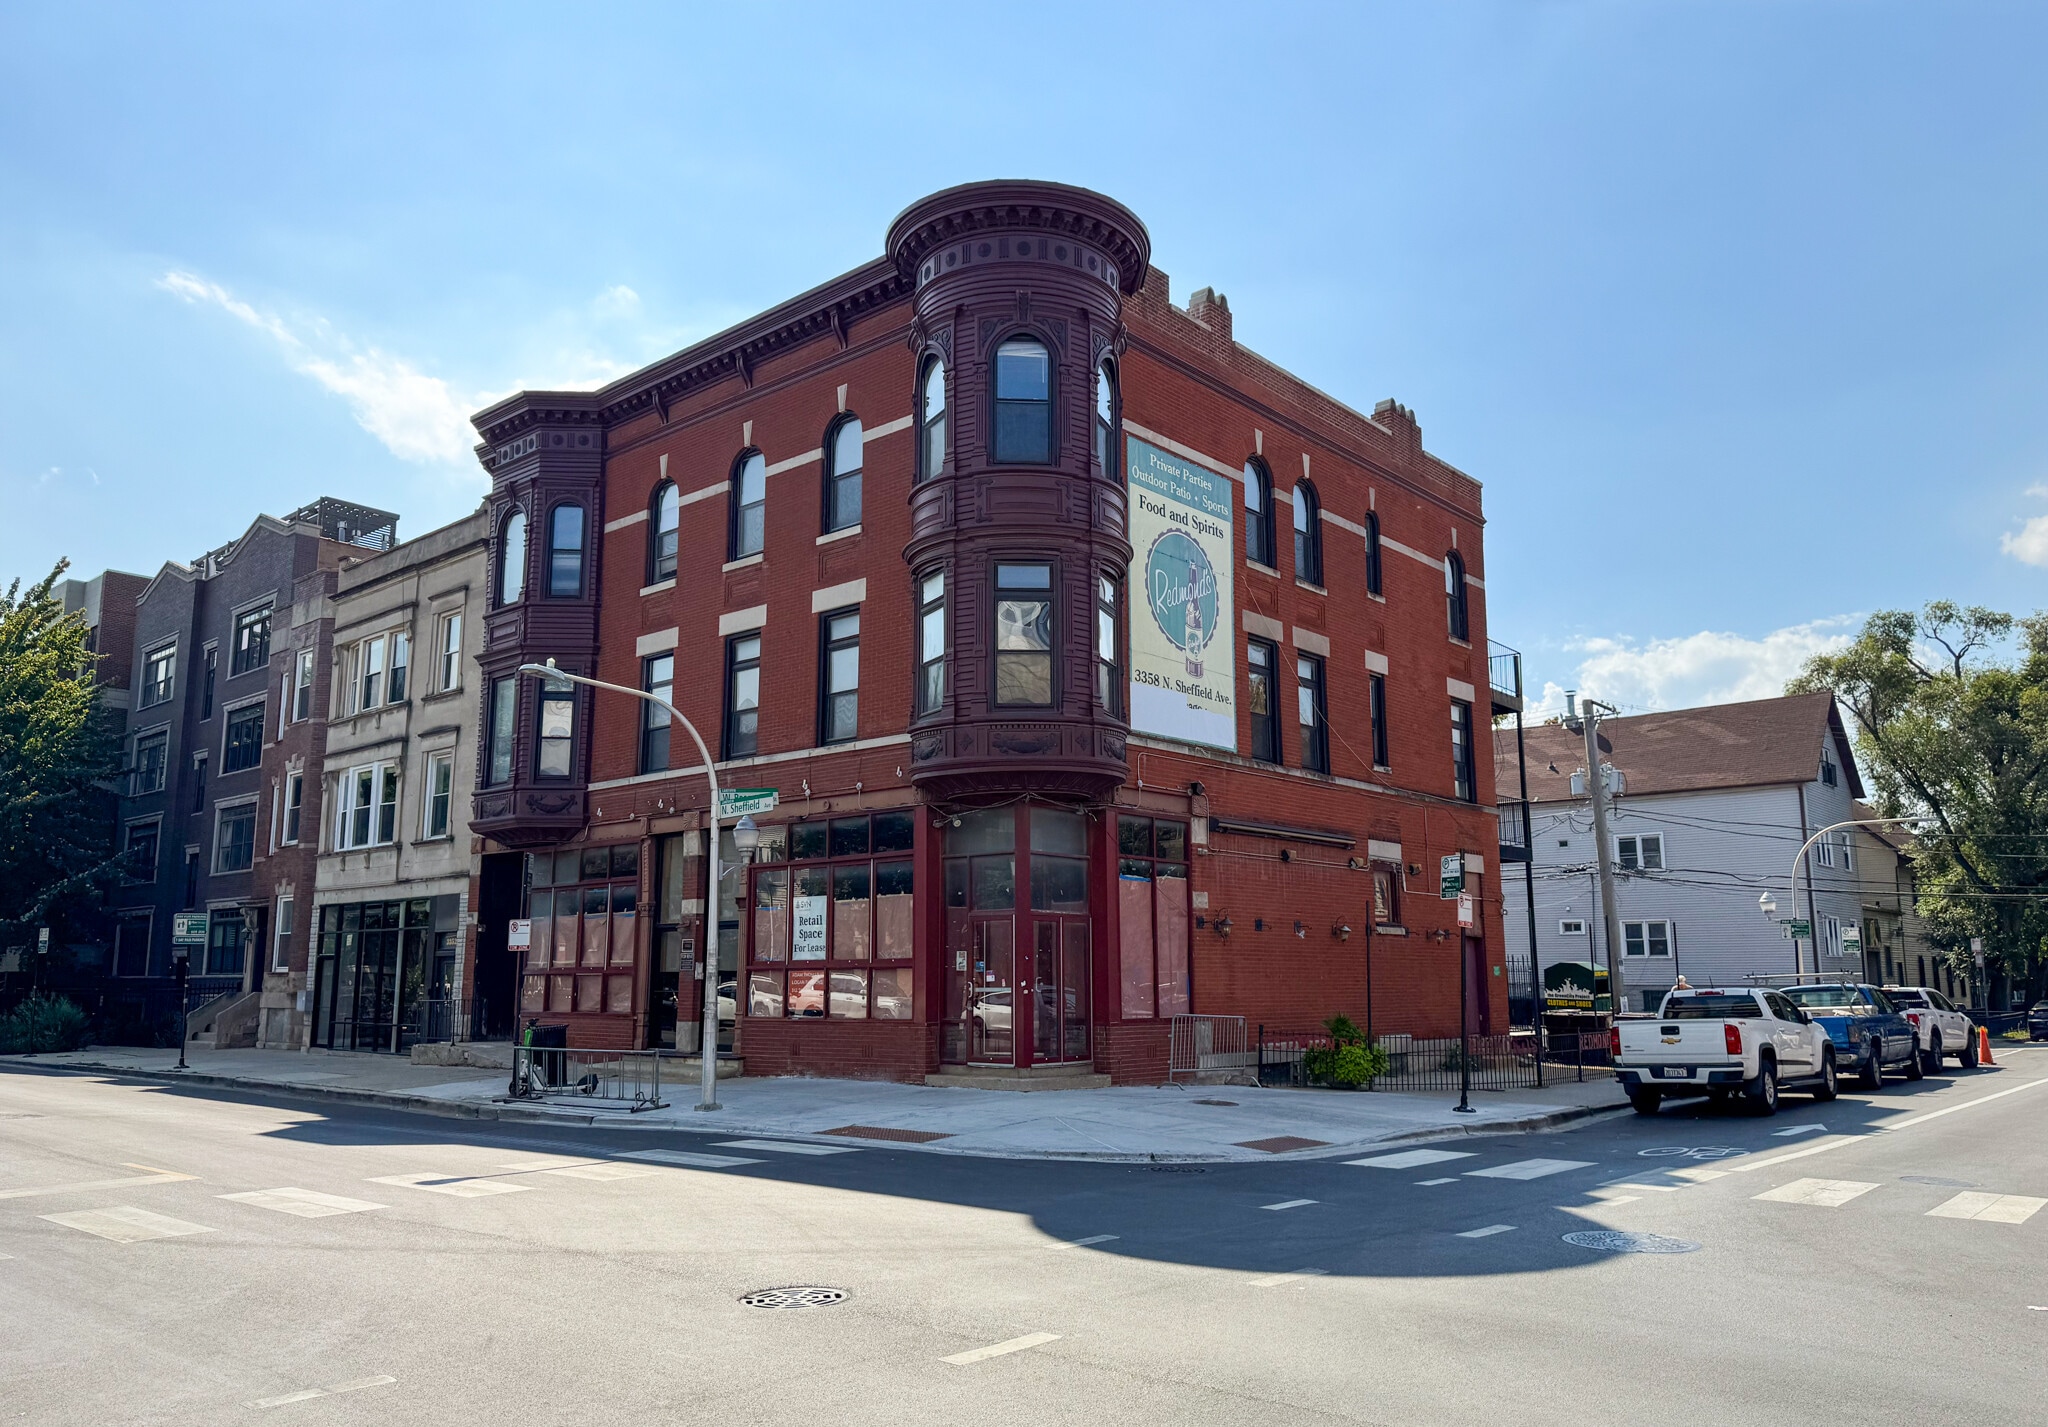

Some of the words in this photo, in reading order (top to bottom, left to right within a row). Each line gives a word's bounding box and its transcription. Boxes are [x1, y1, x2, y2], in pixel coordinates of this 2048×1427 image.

[1149, 453, 1180, 478] Private
[1183, 468, 1212, 491] Parties
[1132, 465, 1168, 491] Outdoor
[1170, 481, 1191, 500] Patio
[1202, 494, 1229, 516] Sports
[1139, 494, 1166, 518] Food
[1169, 510, 1189, 527] and
[1191, 515, 1224, 539] Spirits
[1155, 568, 1212, 615] Redmond's
[1134, 669, 1160, 687] 3358
[1162, 675, 1173, 690] N.
[1175, 679, 1213, 700] Sheffield
[1214, 690, 1232, 705] Ave.
[721, 805, 729, 815] N.
[731, 800, 760, 814] Sheffield
[799, 914, 823, 926] Retail
[793, 944, 806, 953] For
[807, 943, 826, 952] Lease
[798, 929, 823, 942] Space
[1547, 999, 1569, 1007] CLOTHES
[1576, 1000, 1592, 1008] SHOES
